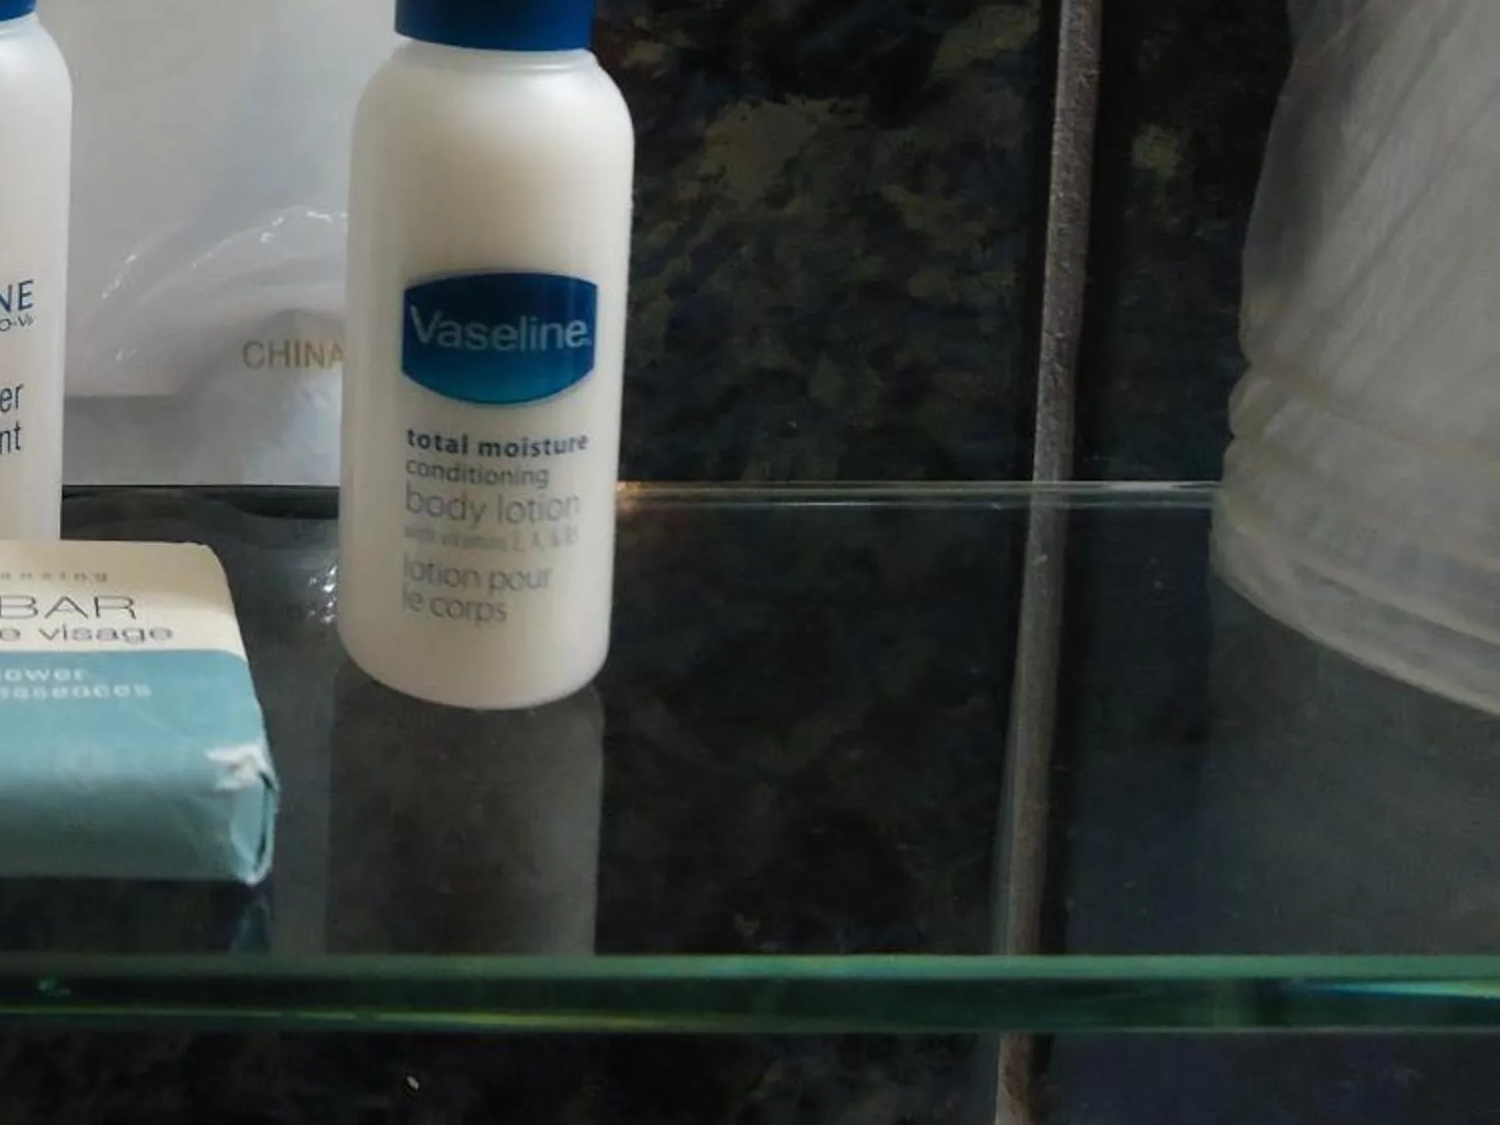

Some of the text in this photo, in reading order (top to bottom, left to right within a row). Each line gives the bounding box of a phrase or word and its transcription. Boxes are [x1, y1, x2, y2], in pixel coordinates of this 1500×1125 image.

[410, 305, 589, 352] Vaseline
[242, 339, 345, 370] CHINA
[406, 428, 590, 457] total moisture
[406, 458, 550, 490] conditioning
[405, 479, 582, 530] body lotion
[429, 597, 508, 628] corps
[38, 624, 174, 644] visage
